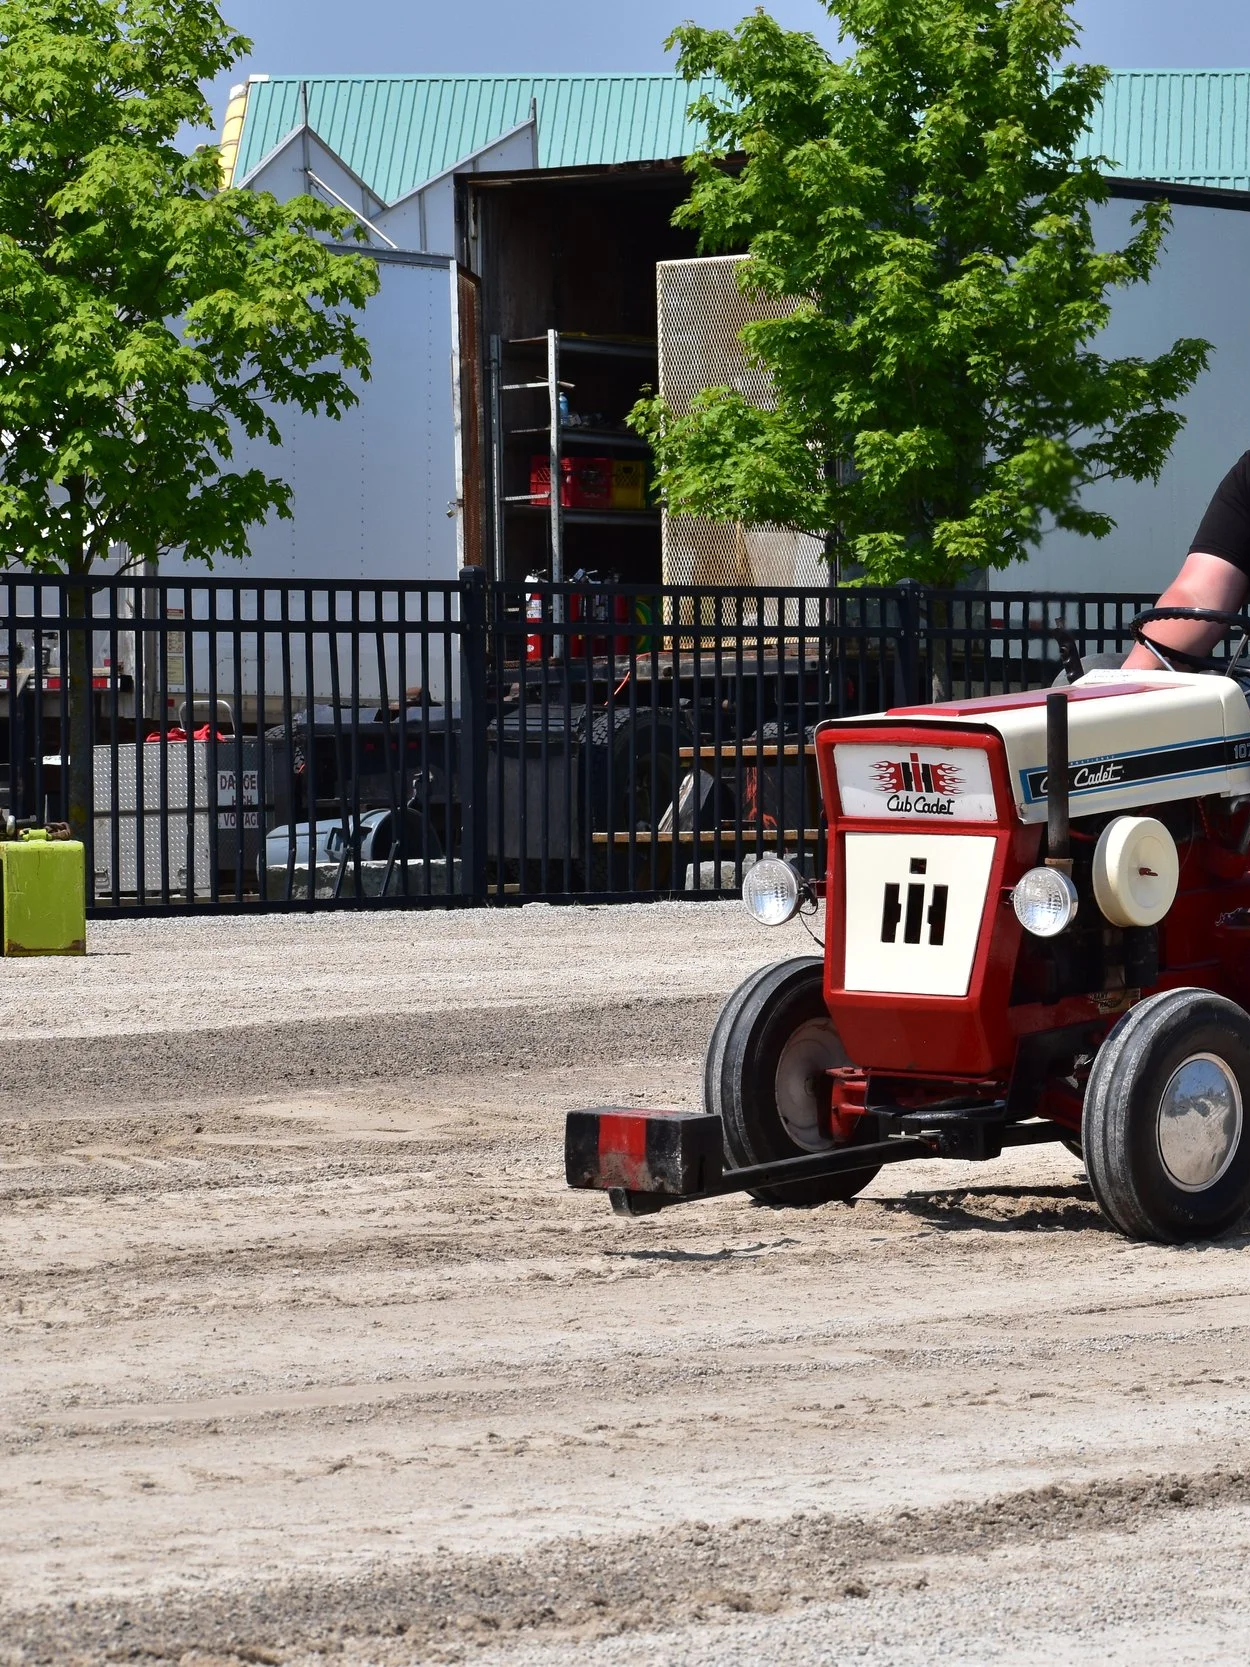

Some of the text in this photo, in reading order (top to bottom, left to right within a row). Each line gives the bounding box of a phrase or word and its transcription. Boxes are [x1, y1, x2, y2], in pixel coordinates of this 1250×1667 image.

[220, 774, 260, 791] DAGE
[1074, 763, 1124, 788] Cadet
[886, 794, 955, 816] Cub Cadet
